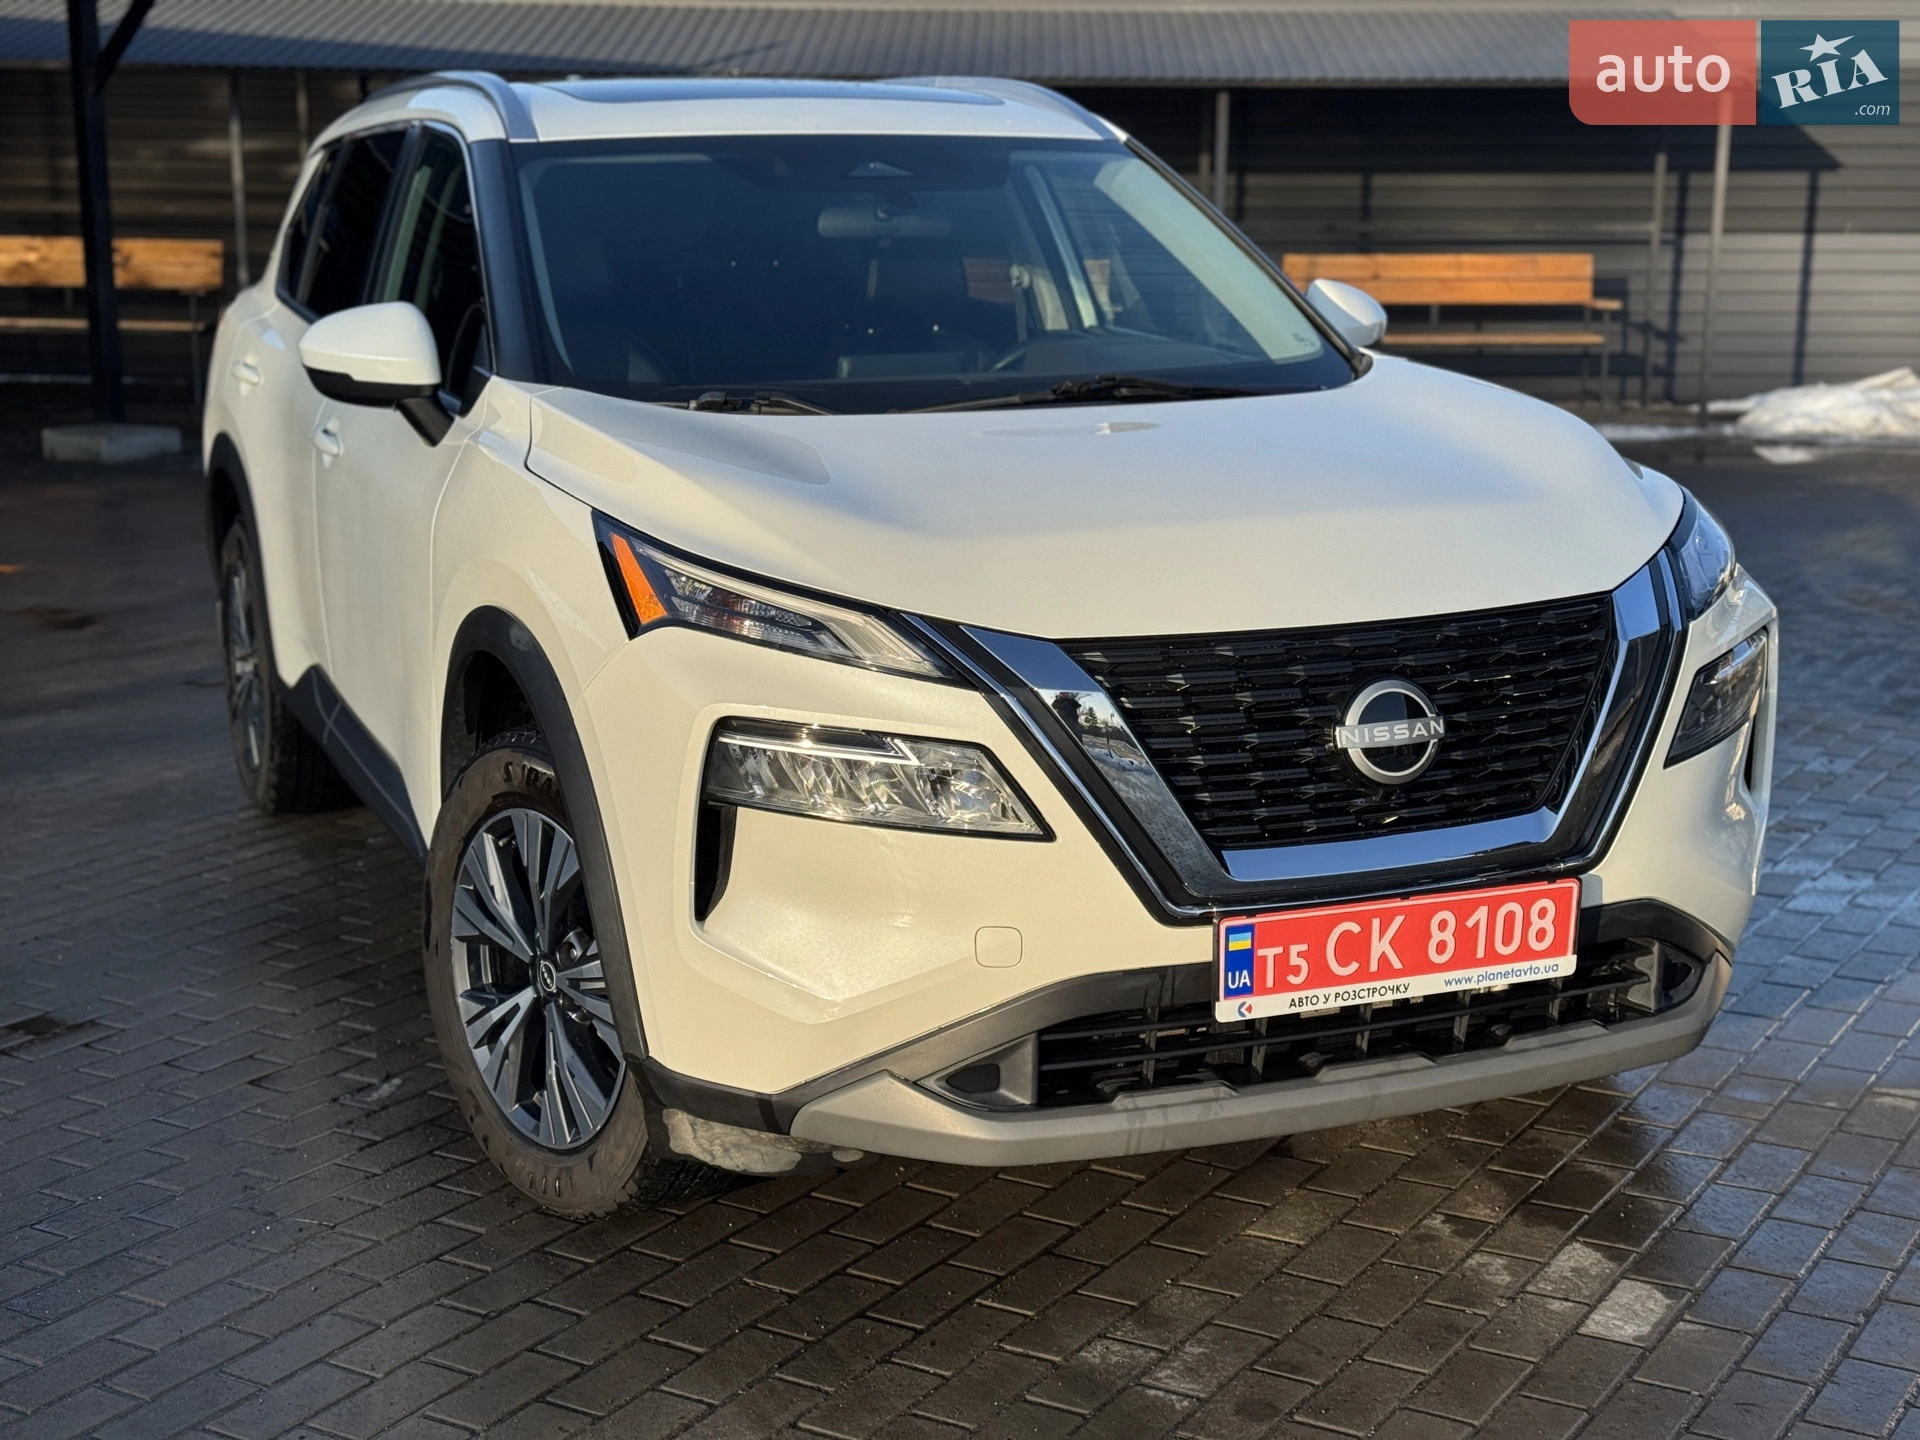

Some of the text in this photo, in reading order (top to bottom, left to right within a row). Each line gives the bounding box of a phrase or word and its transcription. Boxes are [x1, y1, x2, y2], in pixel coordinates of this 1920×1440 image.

[1342, 720, 1444, 744] NISSAN
[1258, 899, 1556, 988] T5 CK 8108
[1228, 971, 1251, 989] UA
[1444, 964, 1559, 985] www.planetavto.ua
[1289, 983, 1411, 1010] АВТО У РОЗСТРОЧКУ
